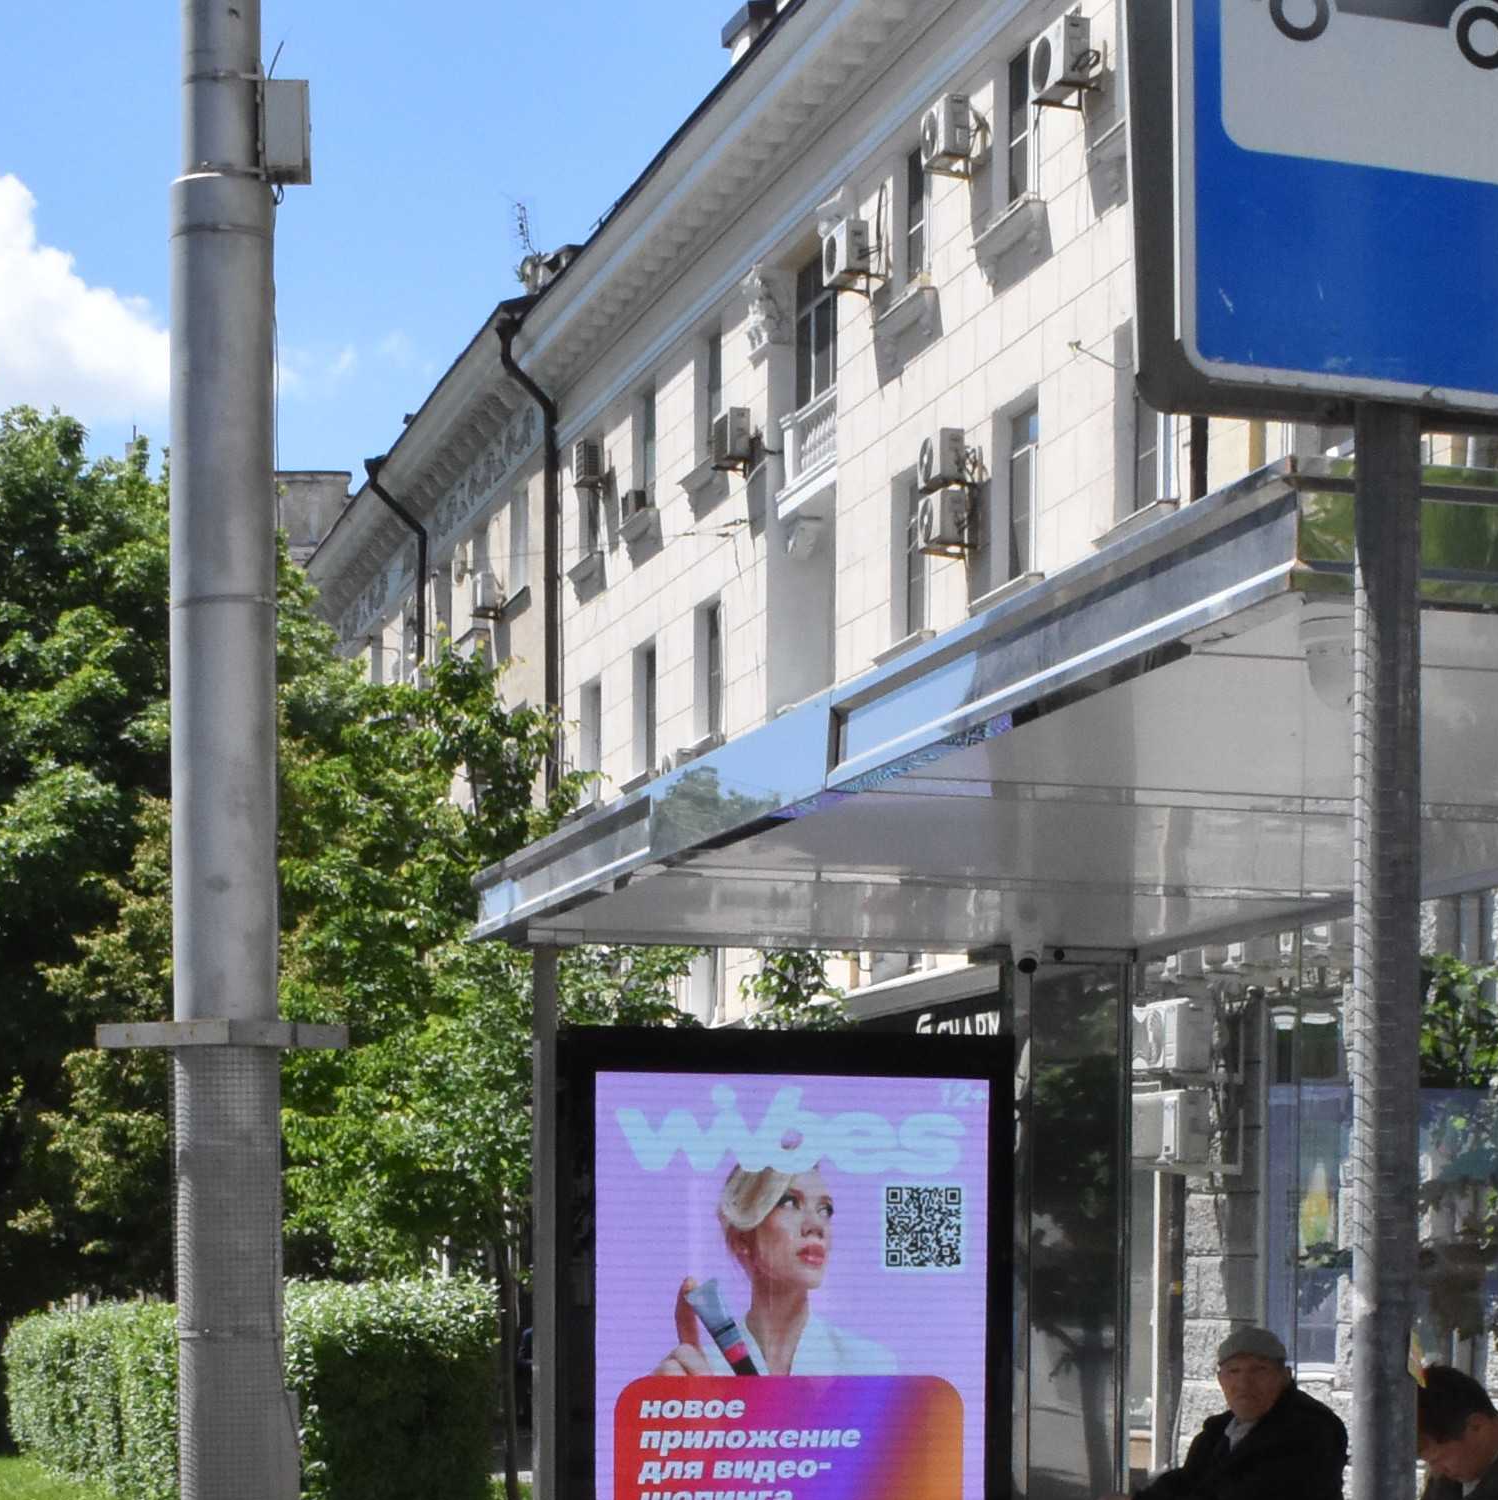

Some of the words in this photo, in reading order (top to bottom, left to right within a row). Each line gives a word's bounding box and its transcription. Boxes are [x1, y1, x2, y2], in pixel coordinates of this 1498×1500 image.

[639, 1399, 746, 1419] новое
[639, 1428, 862, 1457] приложение
[637, 1460, 705, 1484] для
[712, 1459, 832, 1484] видео-
